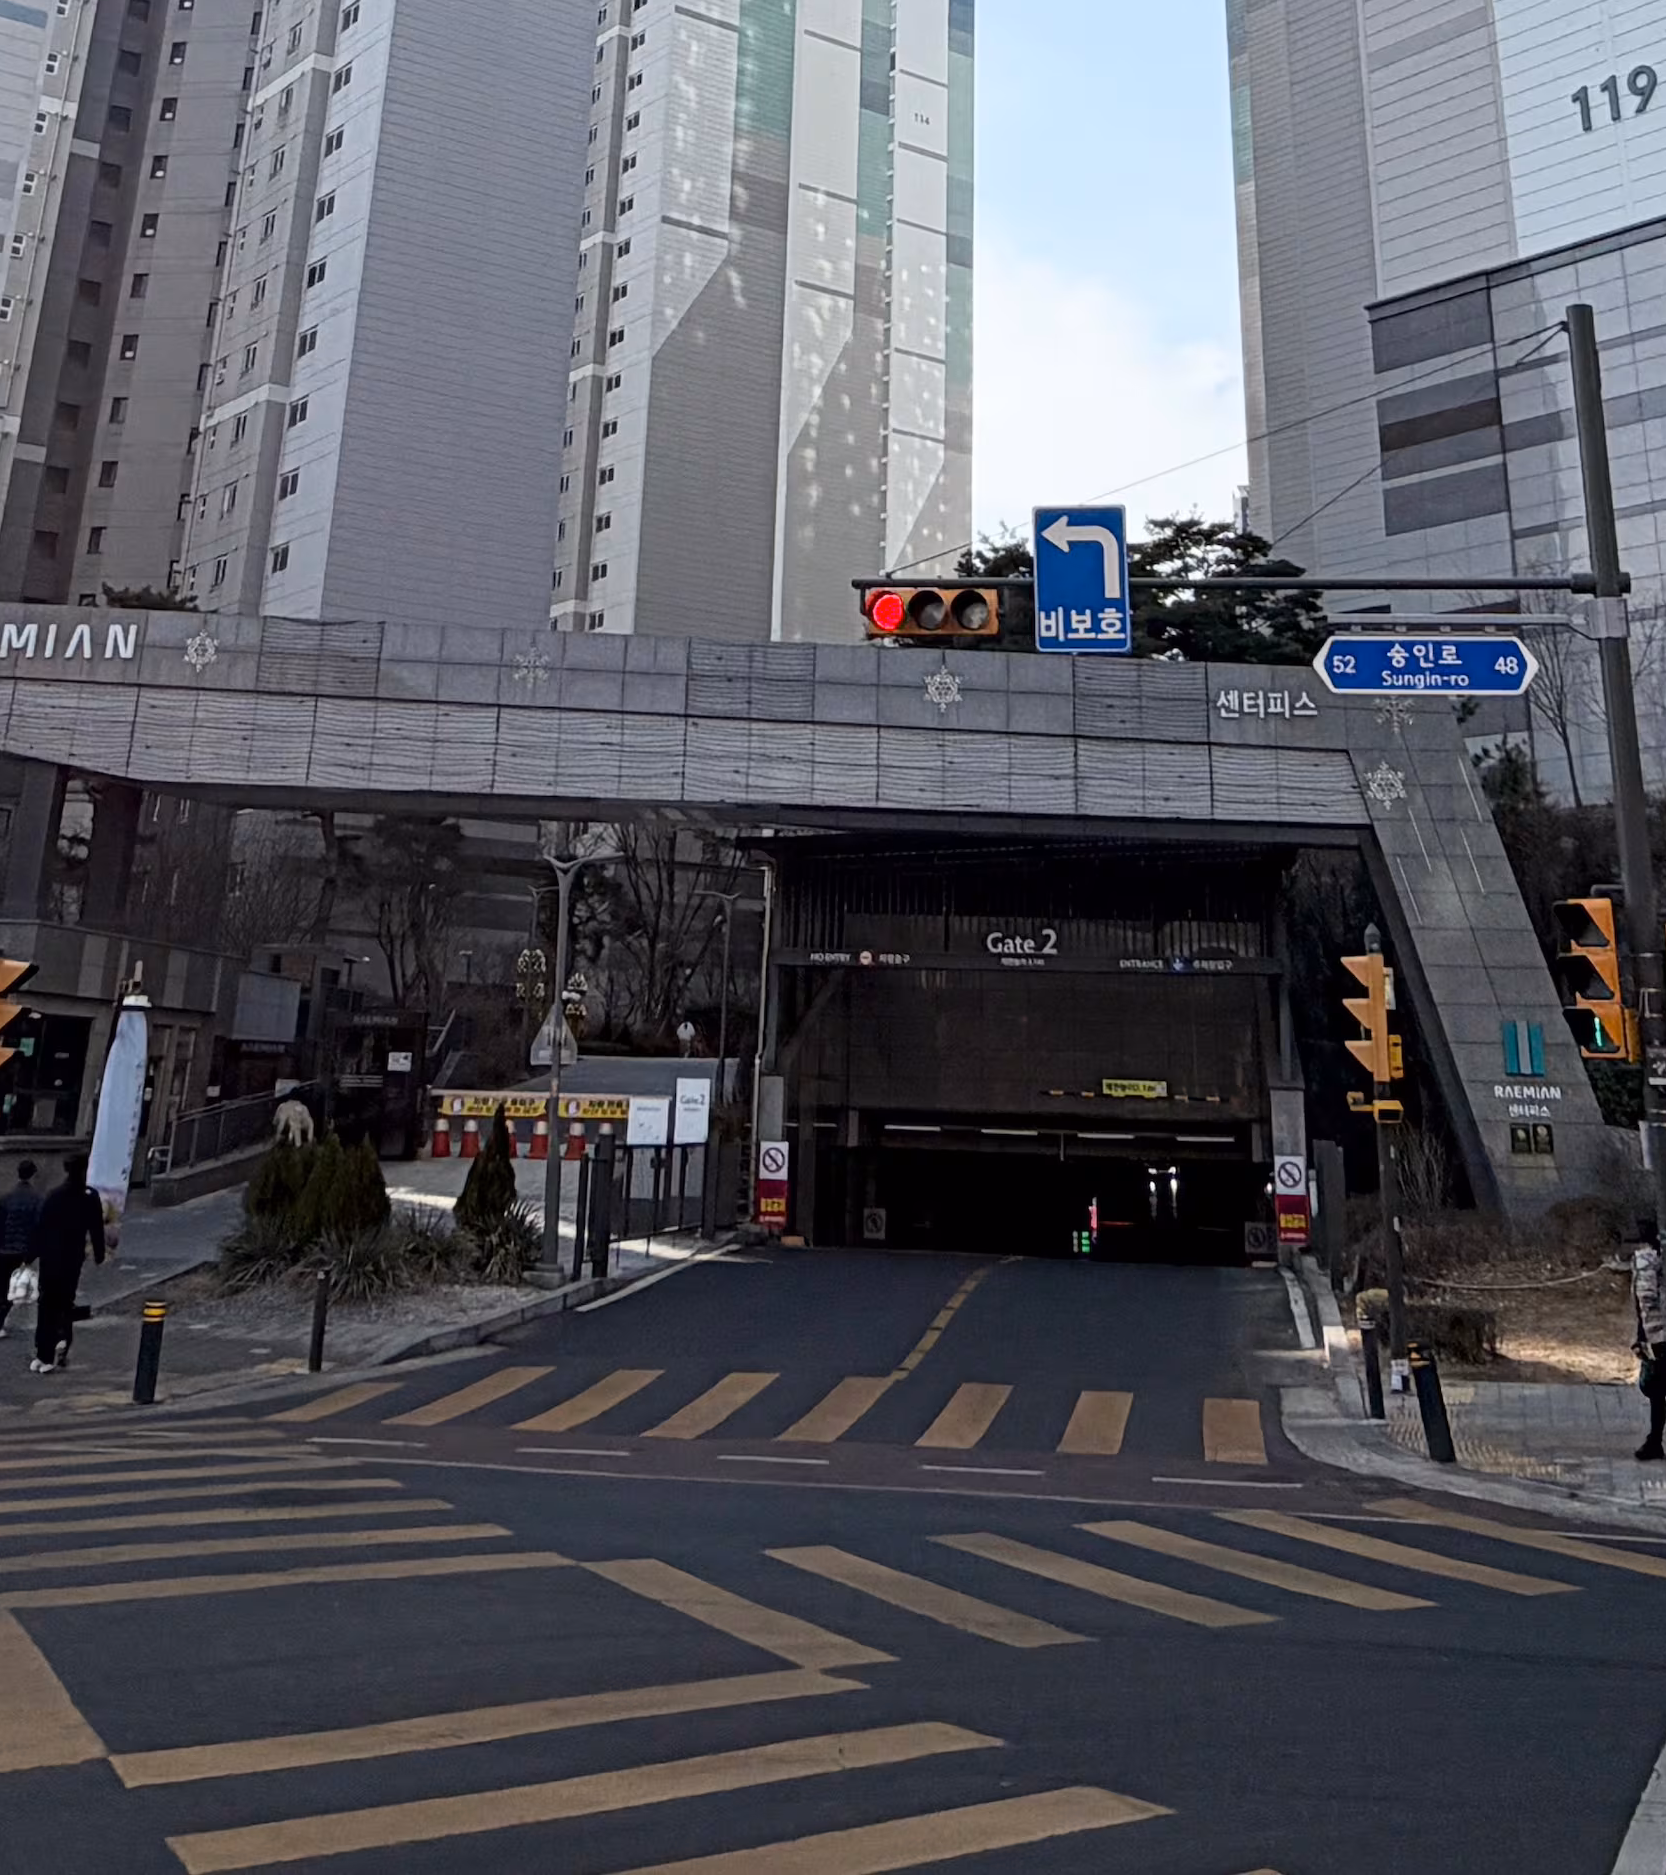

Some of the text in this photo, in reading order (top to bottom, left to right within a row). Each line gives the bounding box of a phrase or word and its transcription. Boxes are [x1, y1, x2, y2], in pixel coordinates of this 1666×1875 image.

[1570, 64, 1658, 133] 119
[1039, 606, 1127, 642] 비보호
[1332, 655, 1520, 675] 52 48
[1386, 642, 1463, 669] 숭인로
[1381, 670, 1470, 689] Sungin-ro
[1216, 689, 1319, 720] 센터피스
[986, 928, 1058, 955] Gate 2
[1493, 1085, 1562, 1100] RAEMIAN
